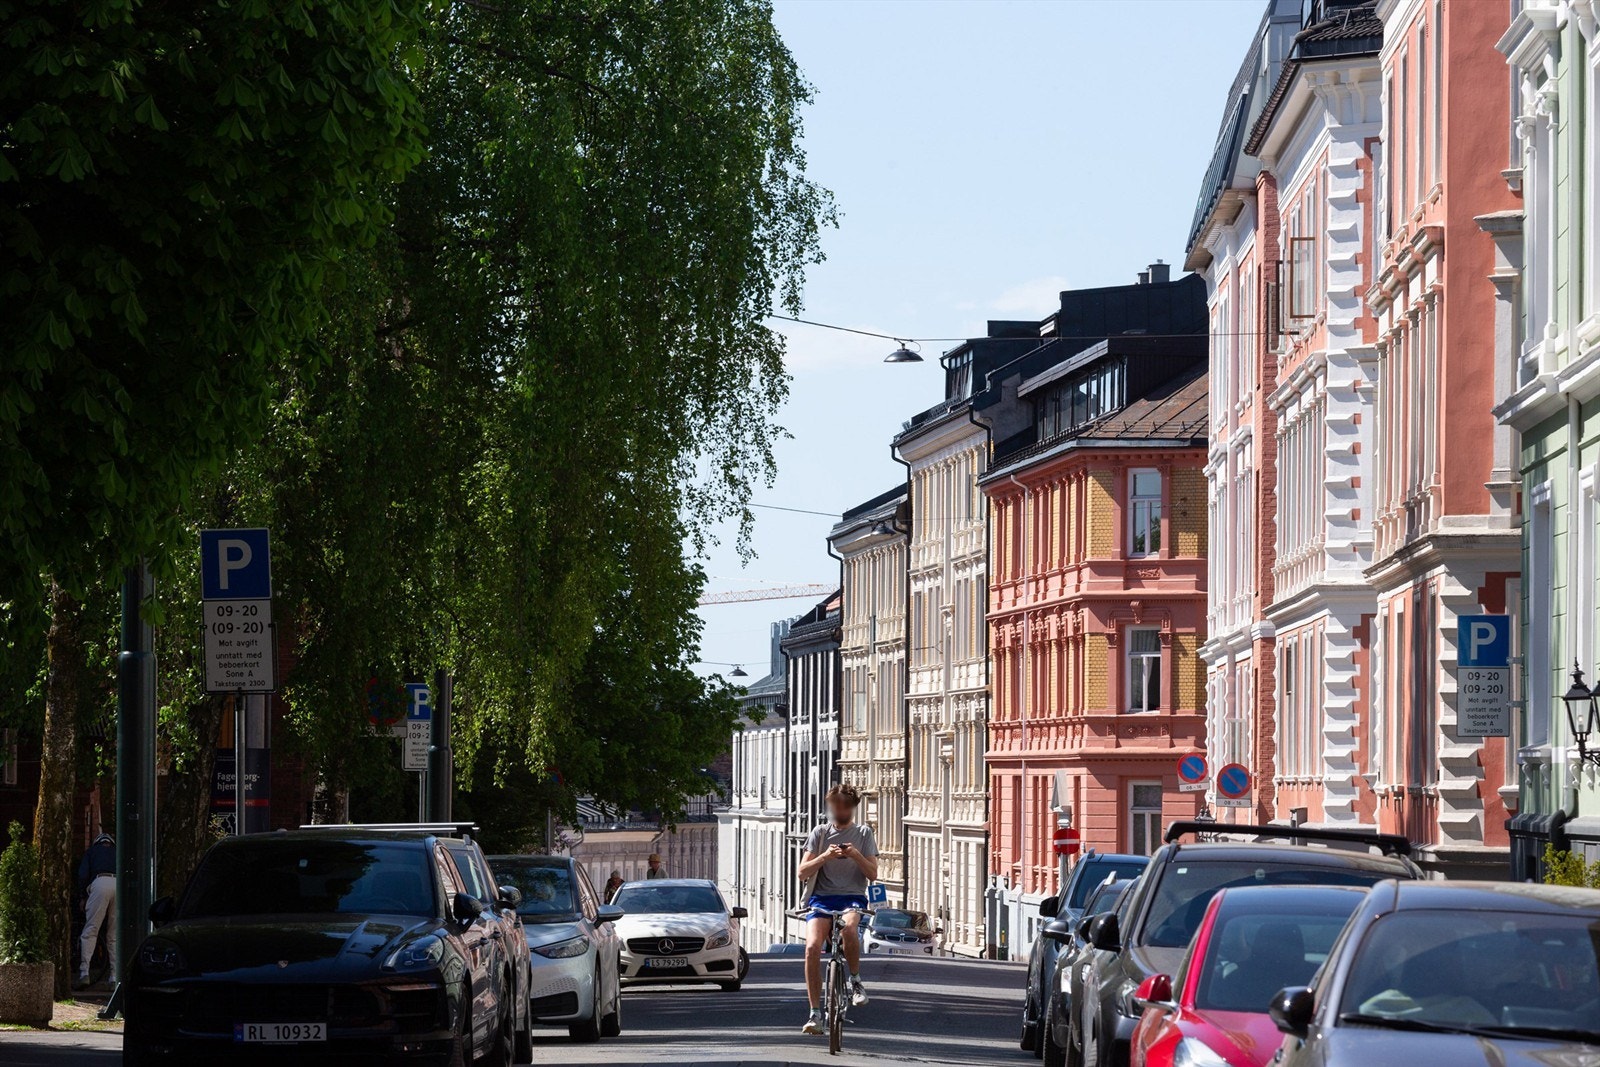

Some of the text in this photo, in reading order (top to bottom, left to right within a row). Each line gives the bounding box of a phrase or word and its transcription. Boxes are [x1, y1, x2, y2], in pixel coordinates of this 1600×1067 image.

[218, 539, 253, 590] P
[218, 639, 258, 648] Mot avgift
[1470, 621, 1497, 660] P
[215, 651, 263, 660] unntatt med
[218, 660, 260, 669] beboerkort
[225, 669, 254, 678] Sone A
[214, 679, 266, 688] Takstsone 2300
[413, 688, 432, 716] P
[1481, 697, 1498, 705] avgift
[872, 887, 882, 901] P
[651, 958, 685, 967] LS 79299
[248, 1025, 267, 1040] RL
[274, 1024, 321, 1040] 10932
